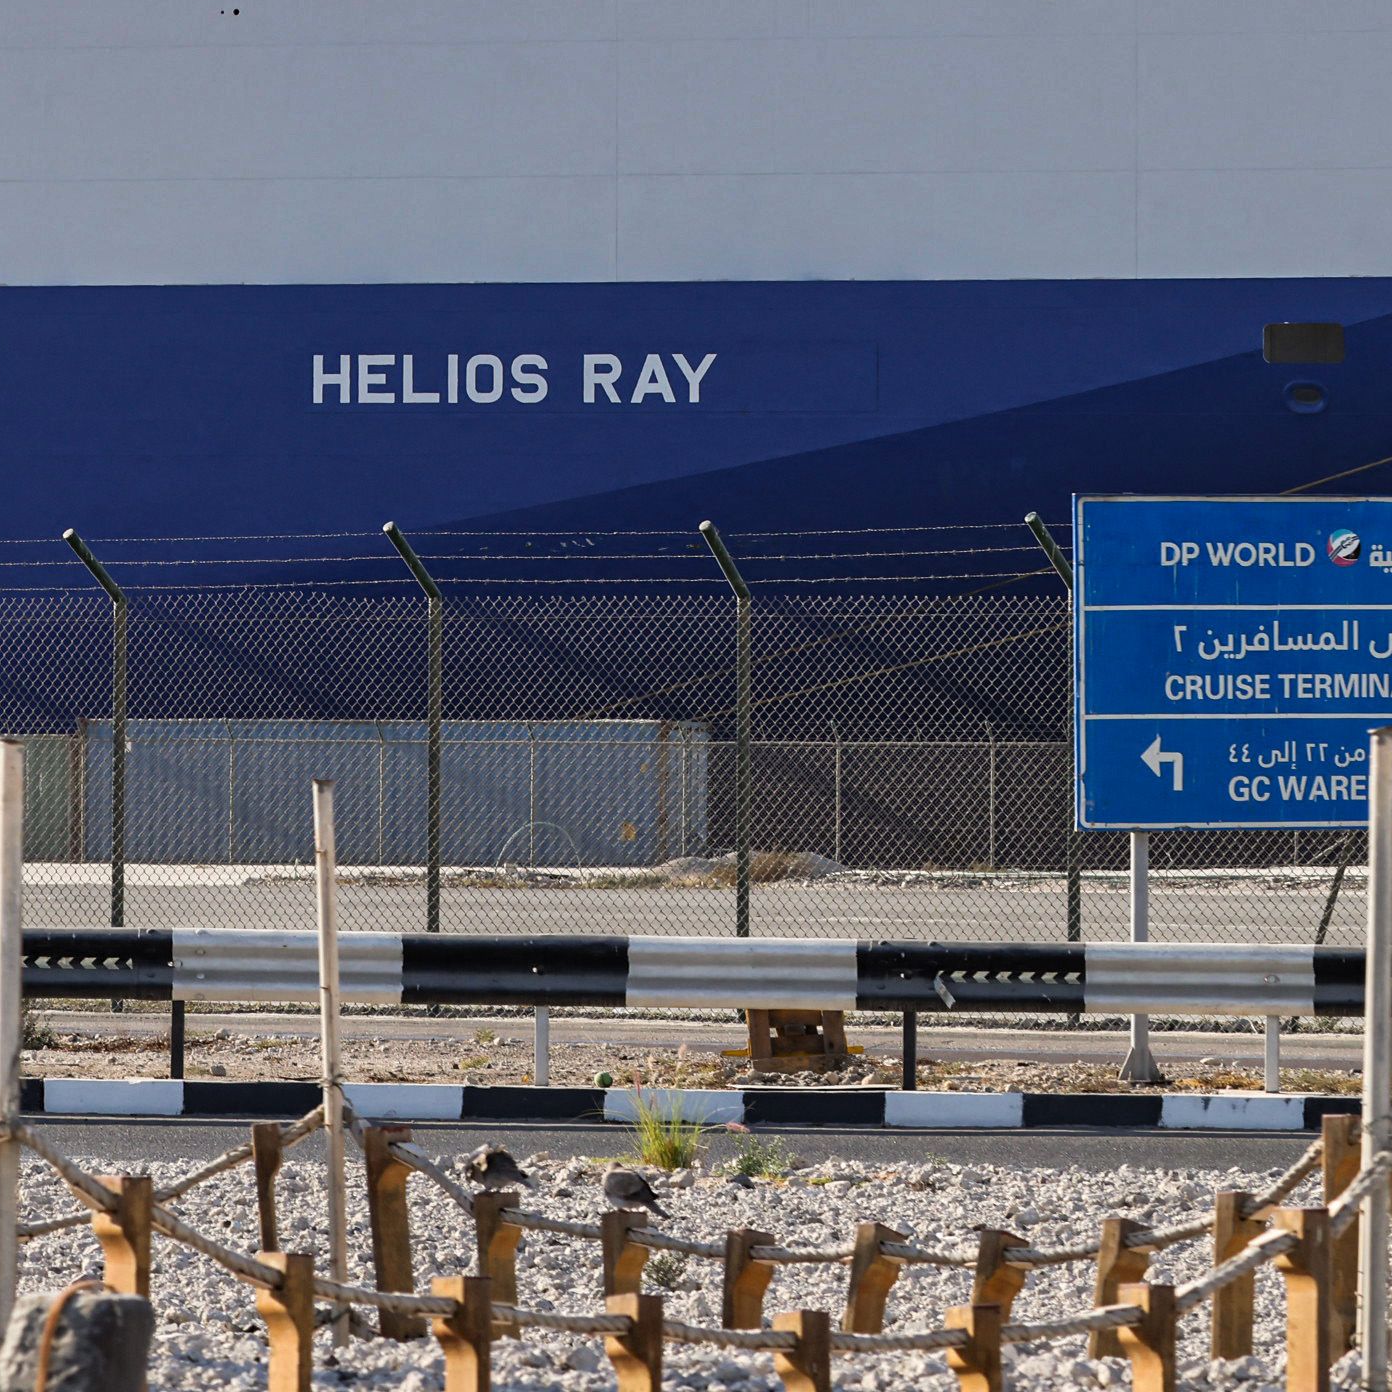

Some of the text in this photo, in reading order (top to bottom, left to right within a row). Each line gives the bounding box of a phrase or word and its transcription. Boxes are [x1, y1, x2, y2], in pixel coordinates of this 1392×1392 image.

[312, 353, 717, 404] HELIOS RAY
[1161, 542, 1315, 567] DP WORLD
[1174, 625, 1187, 652] ٢
[1198, 620, 1359, 660] المسافرين
[1165, 675, 1271, 701] CRUISE
[1229, 743, 1251, 763] ٤٤
[1258, 741, 1297, 770] إلى
[1306, 743, 1329, 762] ٢٢
[1334, 746, 1366, 768] من
[1228, 775, 1270, 802] GC
